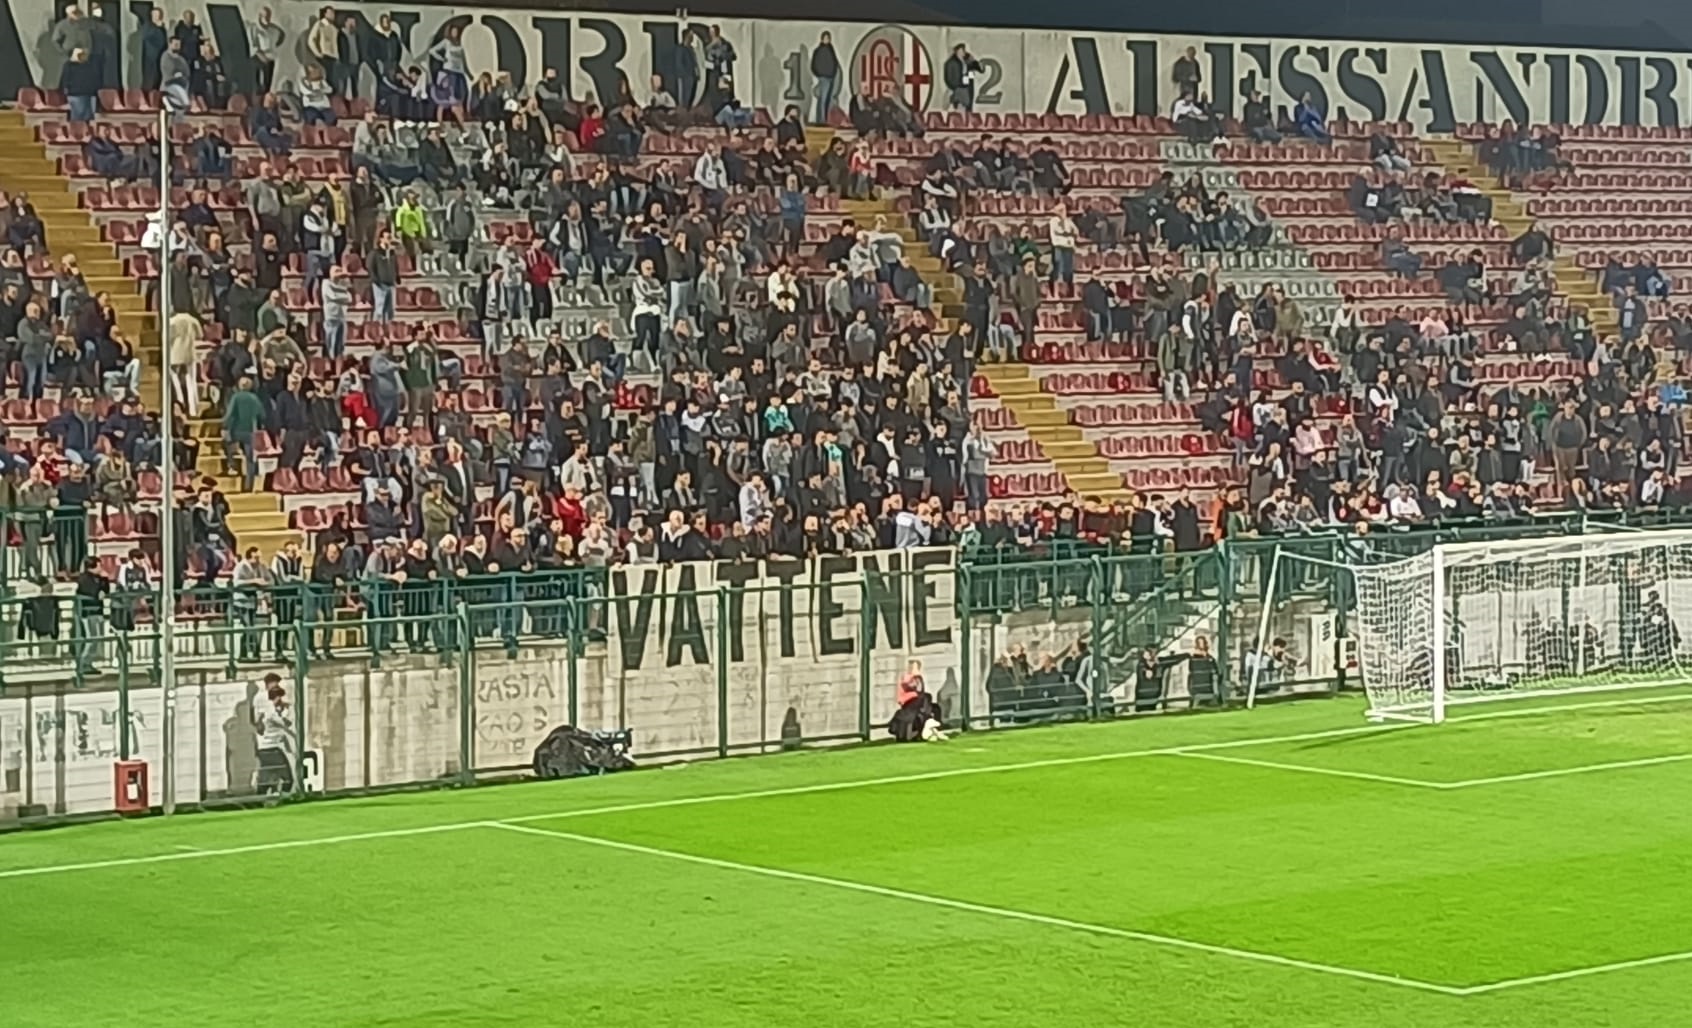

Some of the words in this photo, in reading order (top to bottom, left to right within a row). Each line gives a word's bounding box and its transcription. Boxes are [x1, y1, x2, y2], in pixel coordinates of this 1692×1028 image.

[318, 9, 735, 112] NORD
[1046, 37, 1692, 132] ALESSANDR
[612, 549, 953, 671] VATTENE
